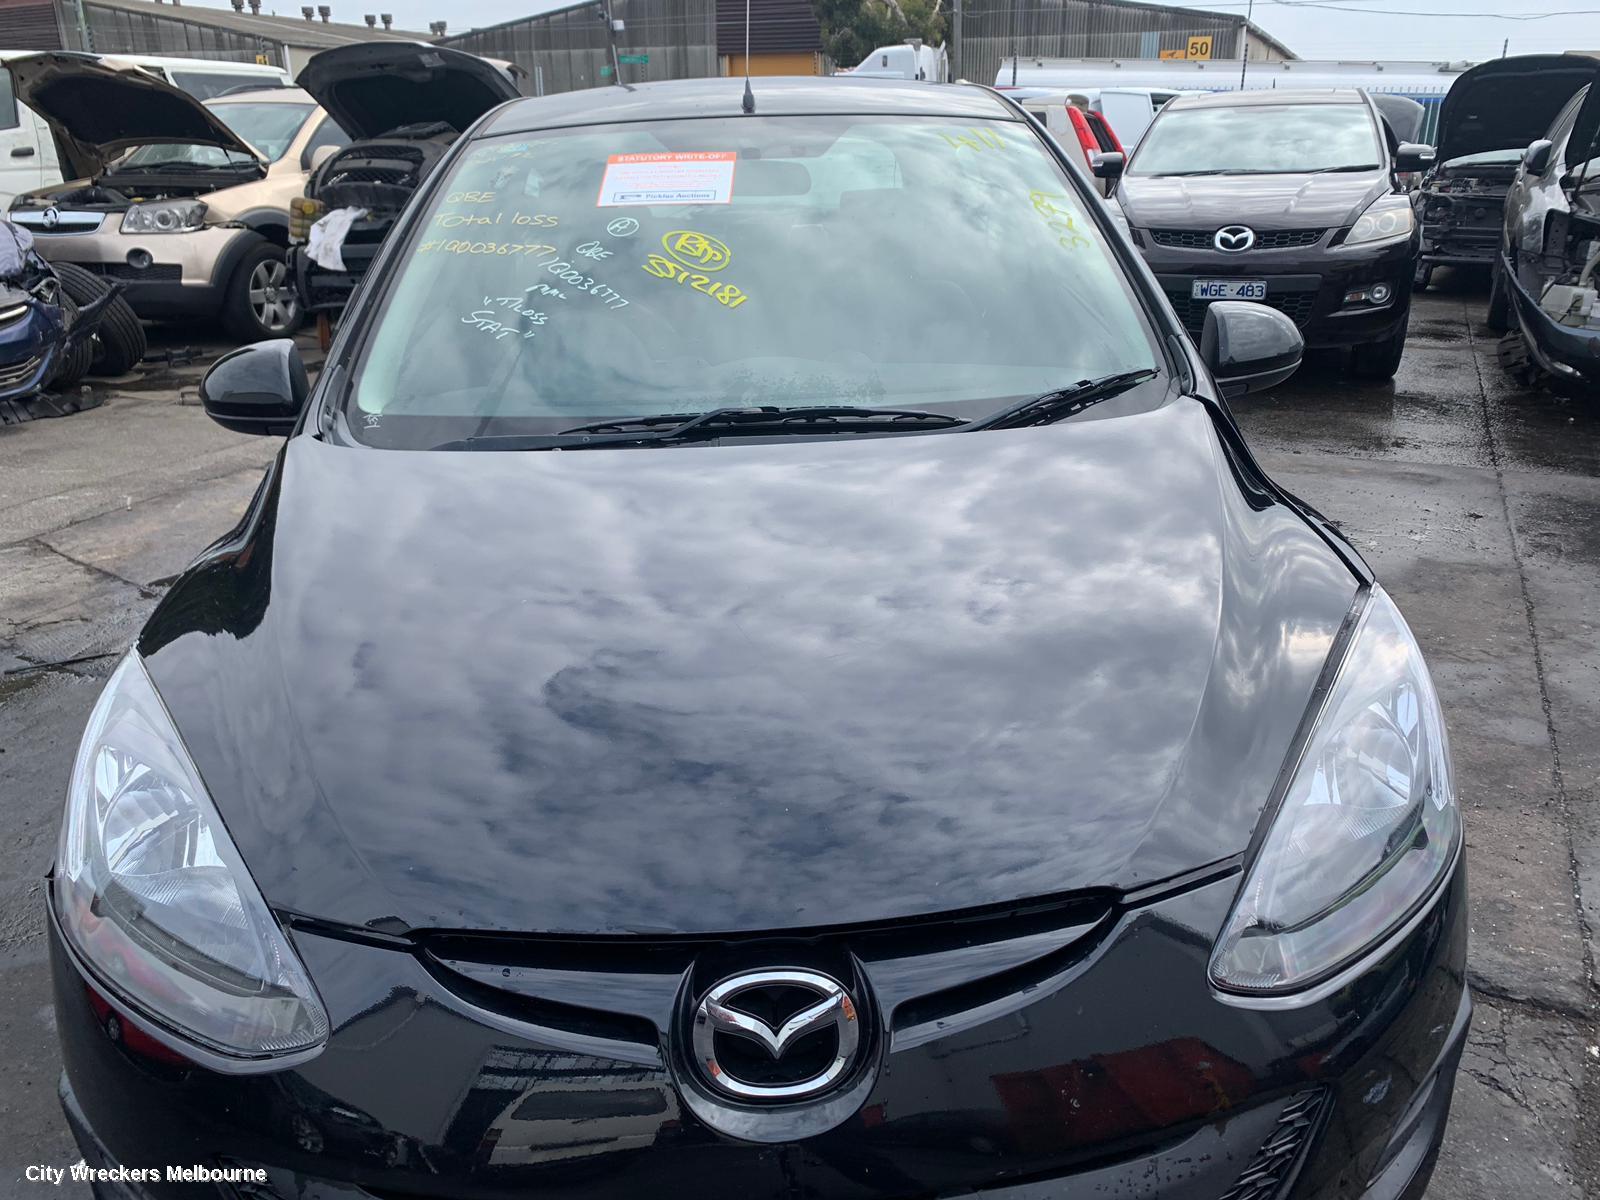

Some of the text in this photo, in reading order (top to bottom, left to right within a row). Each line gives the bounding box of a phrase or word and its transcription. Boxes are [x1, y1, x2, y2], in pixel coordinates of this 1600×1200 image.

[1190, 41, 1209, 56] 50
[617, 154, 673, 162] STATUTORY
[447, 191, 496, 204] QBE
